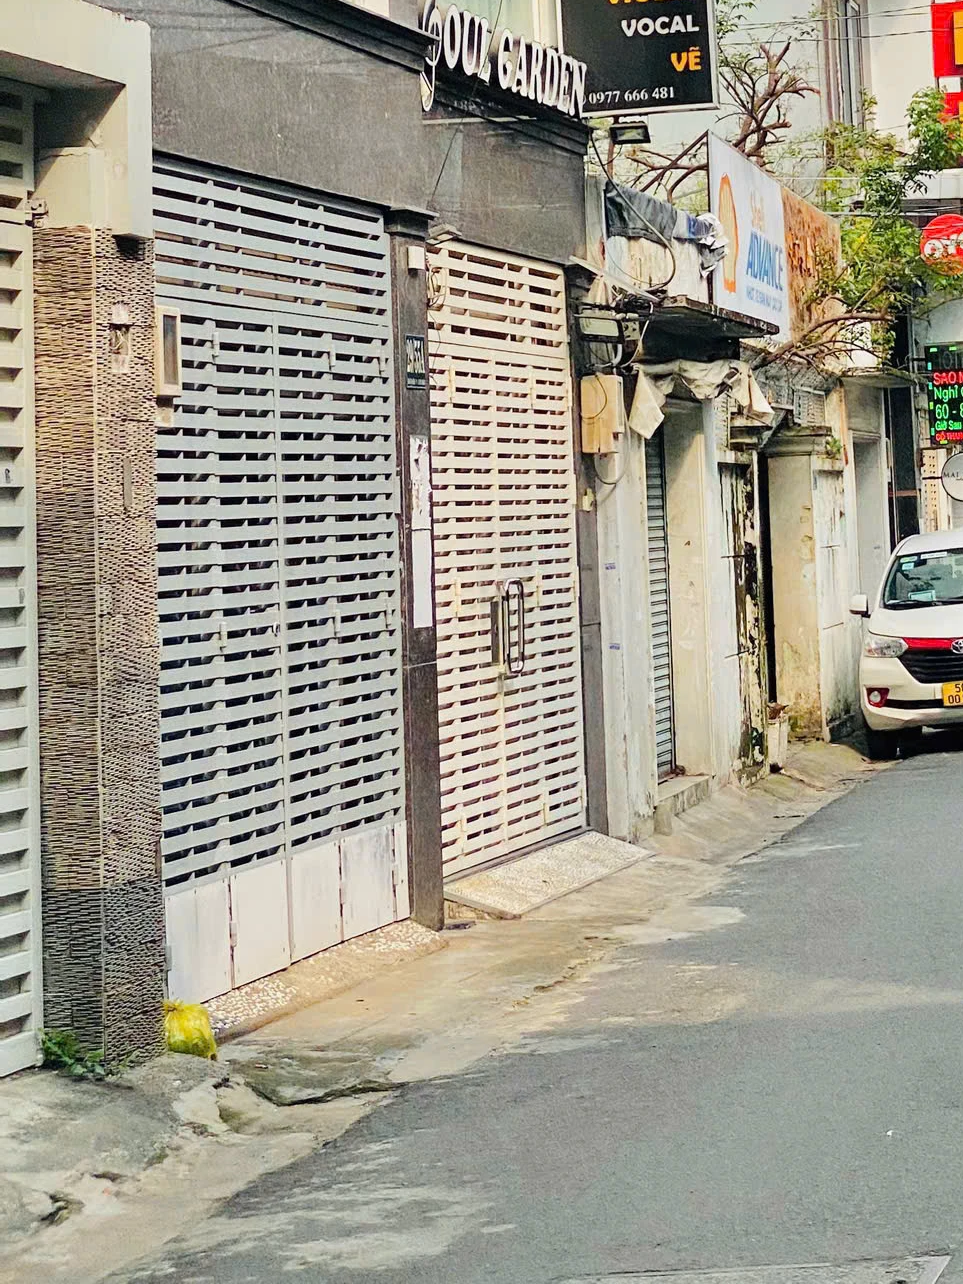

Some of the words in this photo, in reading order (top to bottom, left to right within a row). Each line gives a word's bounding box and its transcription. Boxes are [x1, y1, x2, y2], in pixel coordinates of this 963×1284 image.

[621, 15, 700, 37] VOCAL
[670, 46, 701, 72] VẼ
[498, 28, 587, 118] GARDEN
[588, 91, 620, 105] 0977
[624, 89, 648, 102] 666
[651, 86, 675, 100] 481
[746, 230, 784, 292] ADVANCE
[933, 371, 957, 385] SAO
[935, 404, 949, 419] 60
